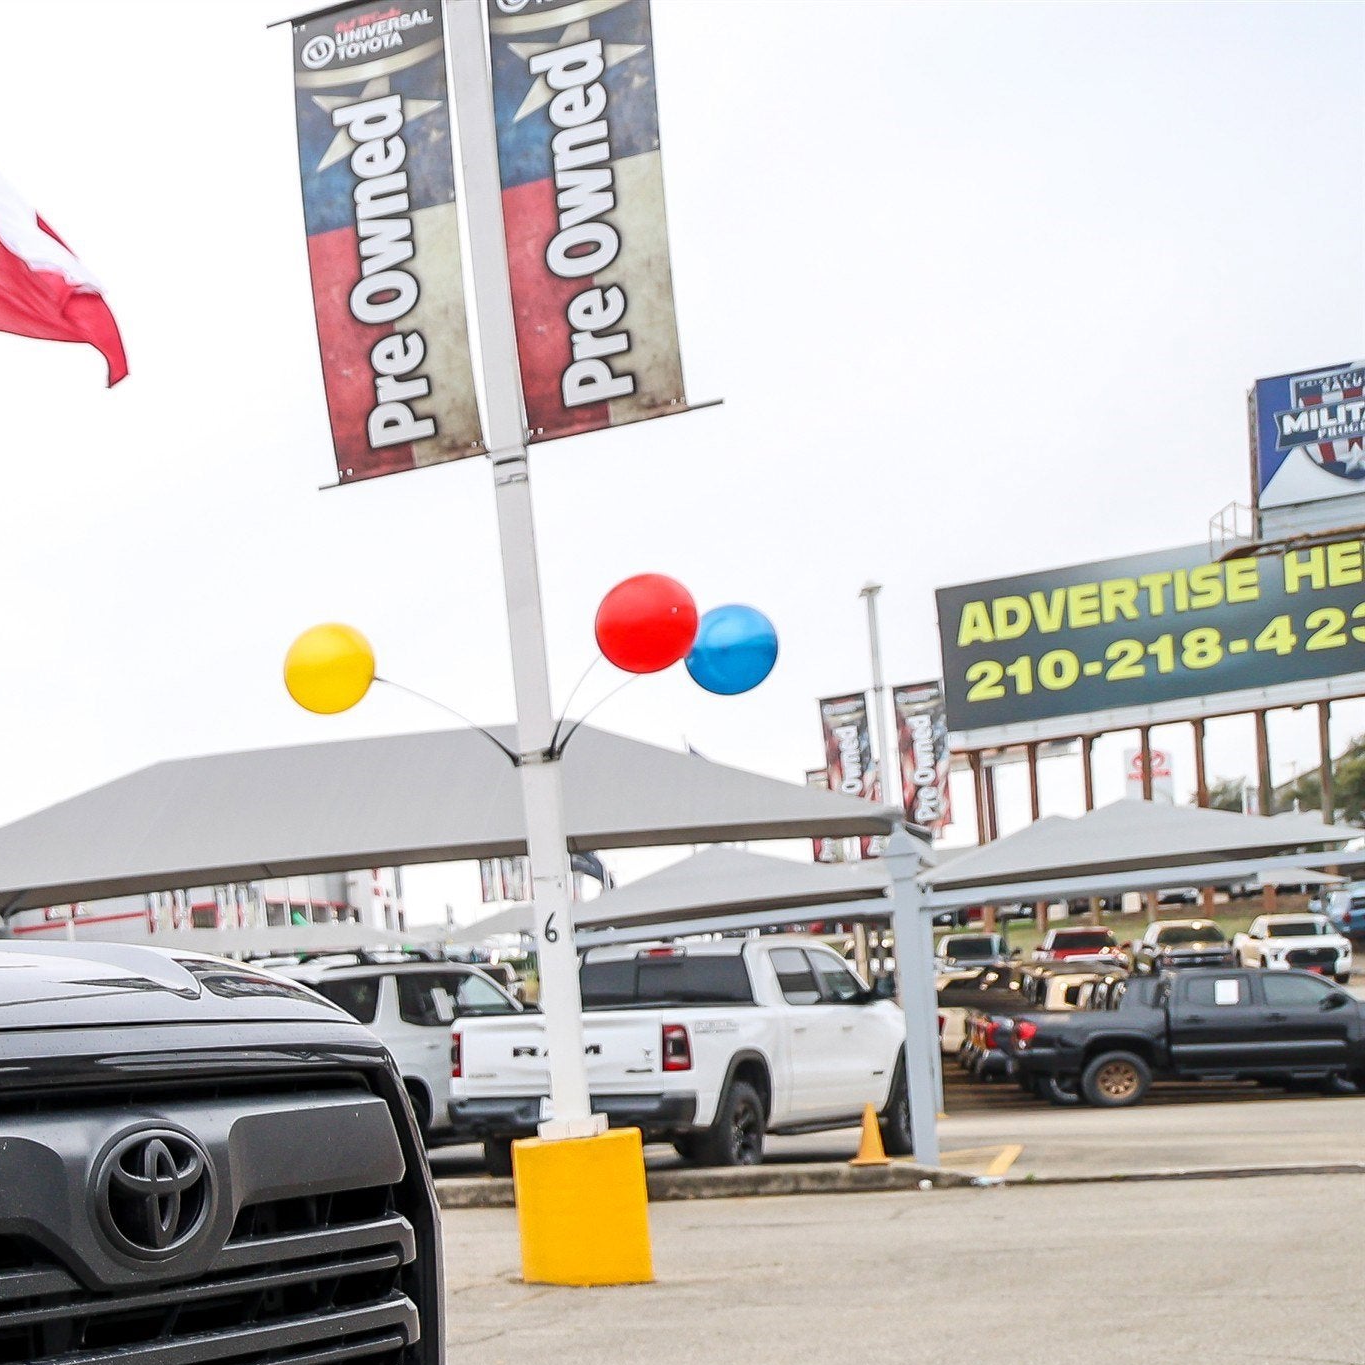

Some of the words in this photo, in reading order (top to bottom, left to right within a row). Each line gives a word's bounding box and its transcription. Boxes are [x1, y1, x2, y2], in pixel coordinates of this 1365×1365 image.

[336, 8, 434, 46] UNIVERSAL
[337, 31, 404, 61] TOYOTA
[528, 38, 620, 278] Owned
[332, 94, 421, 324] Owned
[367, 330, 436, 448] Pre
[561, 286, 635, 408] Pre
[1282, 401, 1365, 436] MILIT
[957, 557, 1260, 647] ADVERTISE
[544, 911, 558, 943] 6
